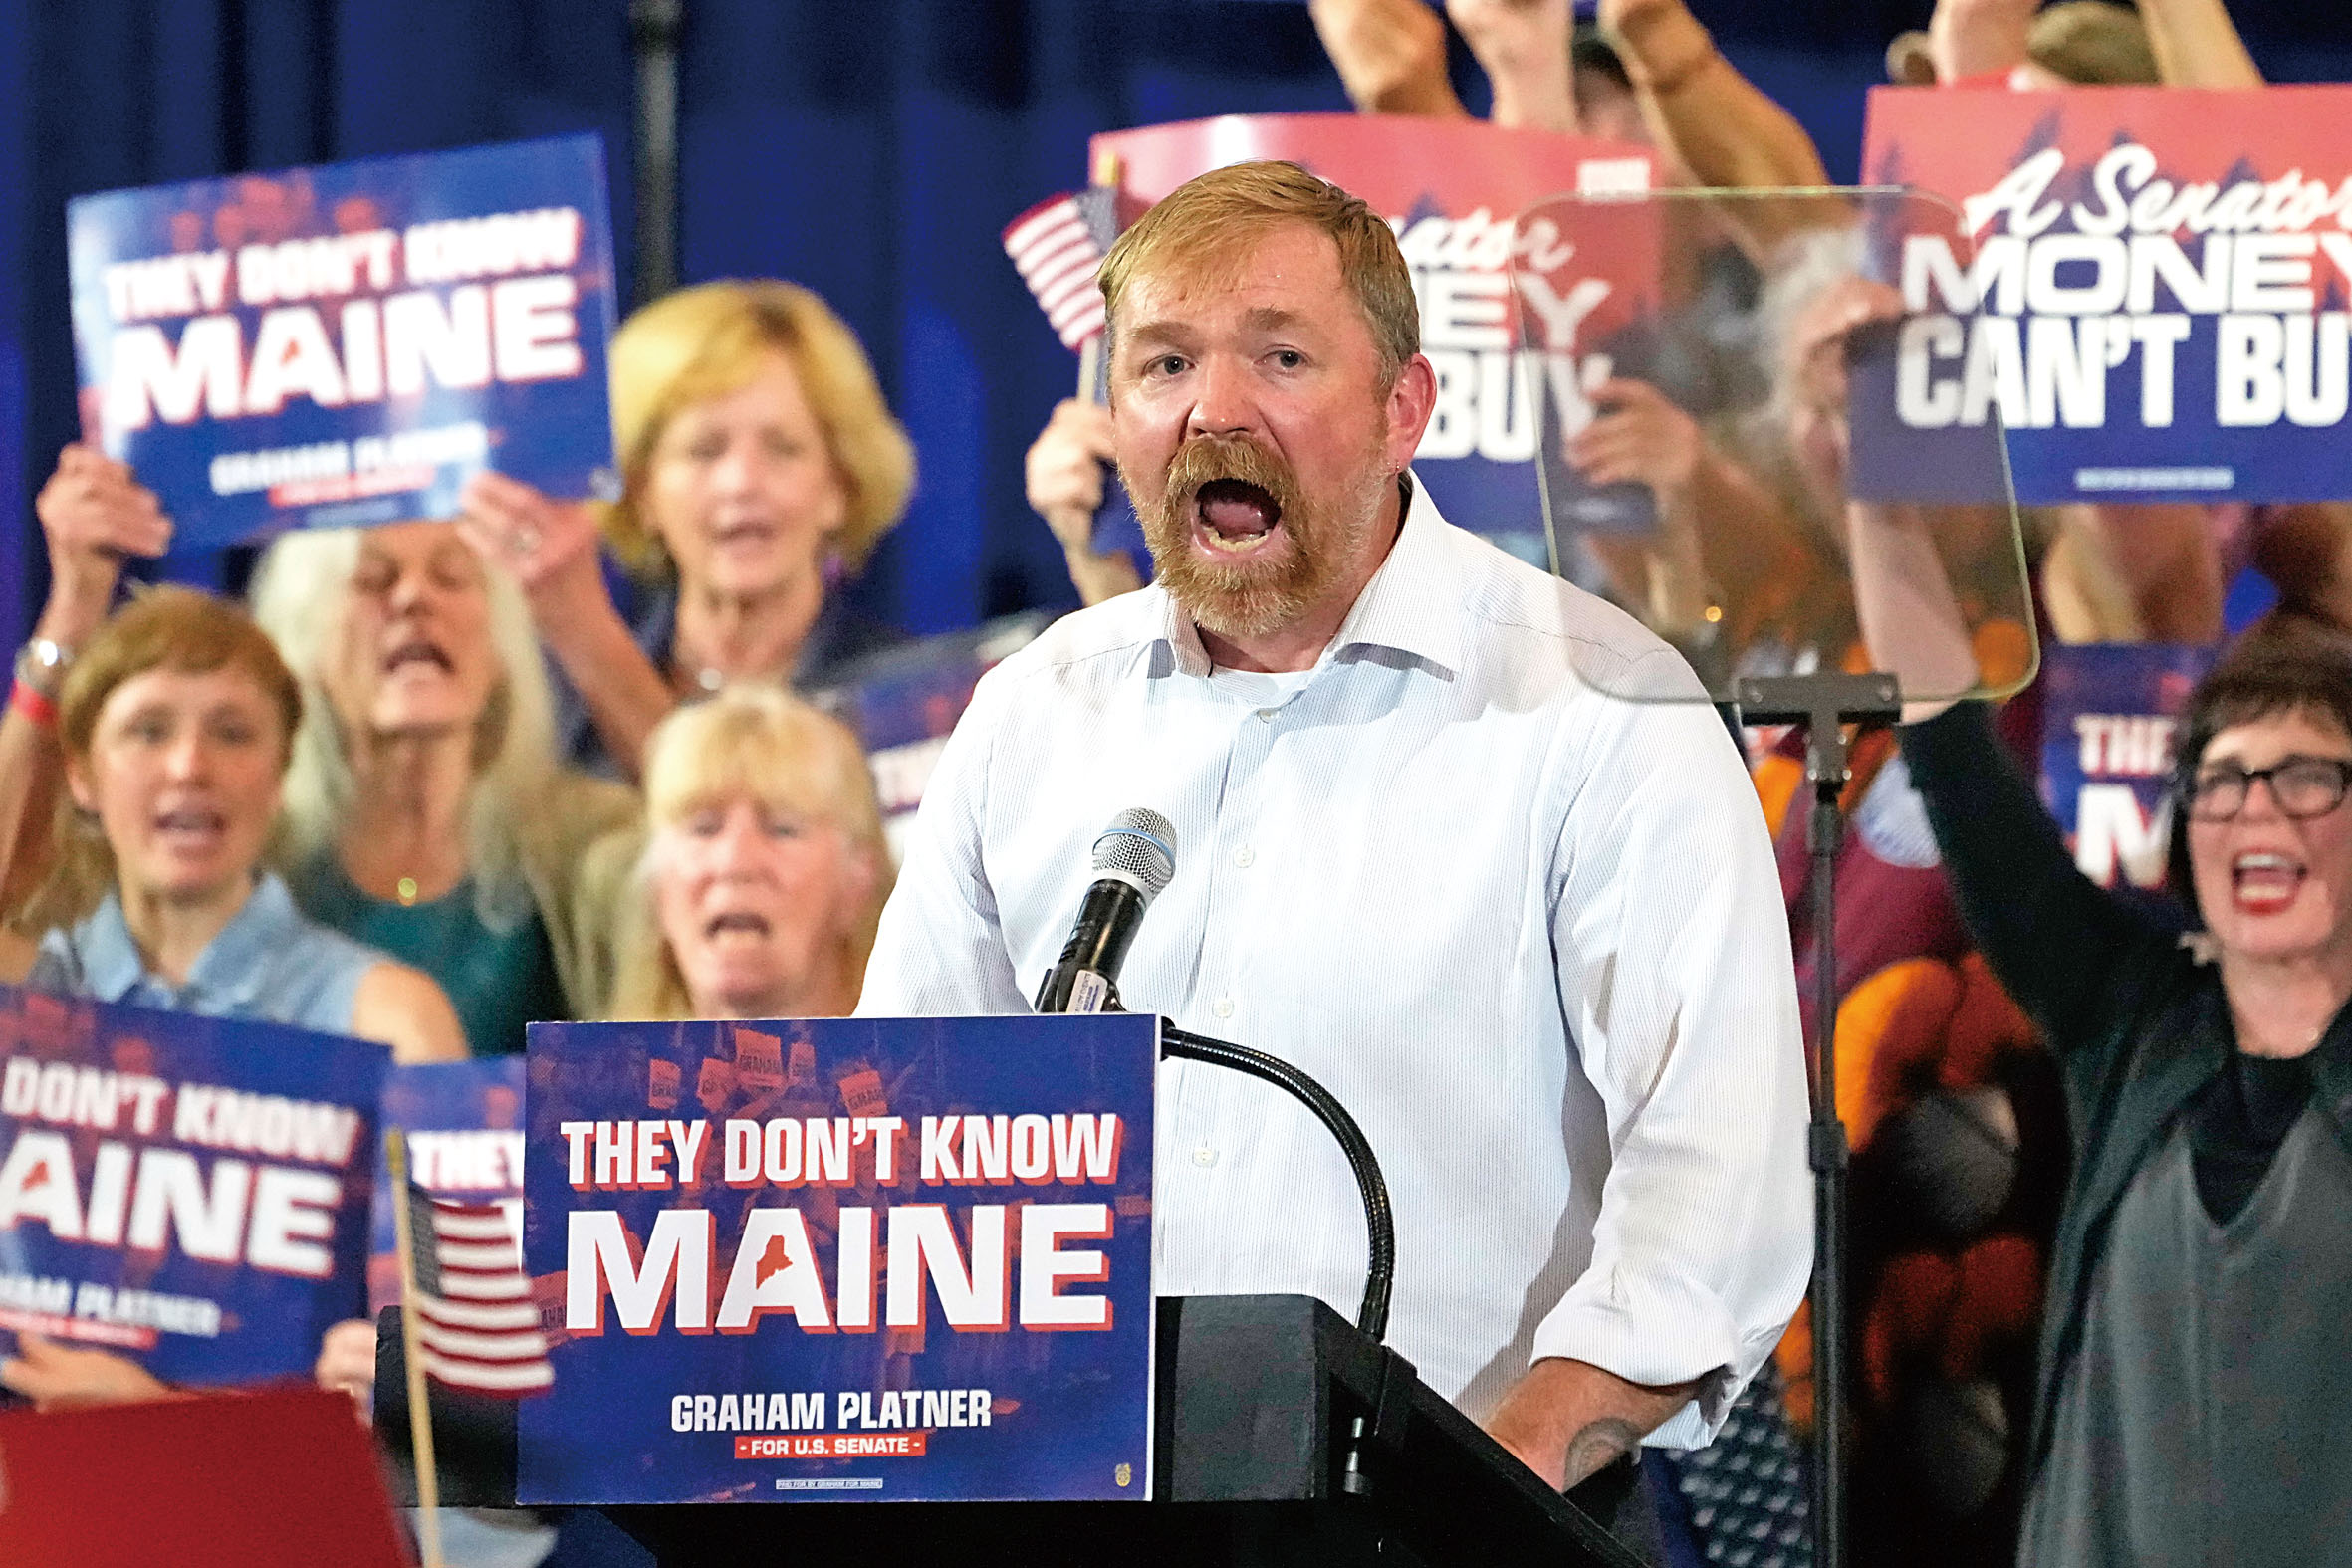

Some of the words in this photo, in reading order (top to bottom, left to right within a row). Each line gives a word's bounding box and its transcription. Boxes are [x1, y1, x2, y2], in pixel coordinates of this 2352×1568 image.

[1960, 146, 2065, 237] A
[104, 251, 229, 321] THEY
[237, 229, 398, 305] DON'T
[107, 275, 585, 431] MAINE
[1897, 312, 2193, 429] CAN'T
[2, 1055, 169, 1137] DON'T
[172, 1082, 361, 1167] KNOW
[560, 1119, 708, 1187] THEY
[724, 1115, 904, 1185] DON'T
[920, 1112, 1120, 1183] KNOW
[565, 1203, 1112, 1334] MAINE
[671, 1393, 825, 1432] GRAHAM
[837, 1390, 992, 1430] PLATNER
[750, 1440, 790, 1456] FOR
[794, 1439, 829, 1455] U.S.
[834, 1437, 909, 1454] SENATE
